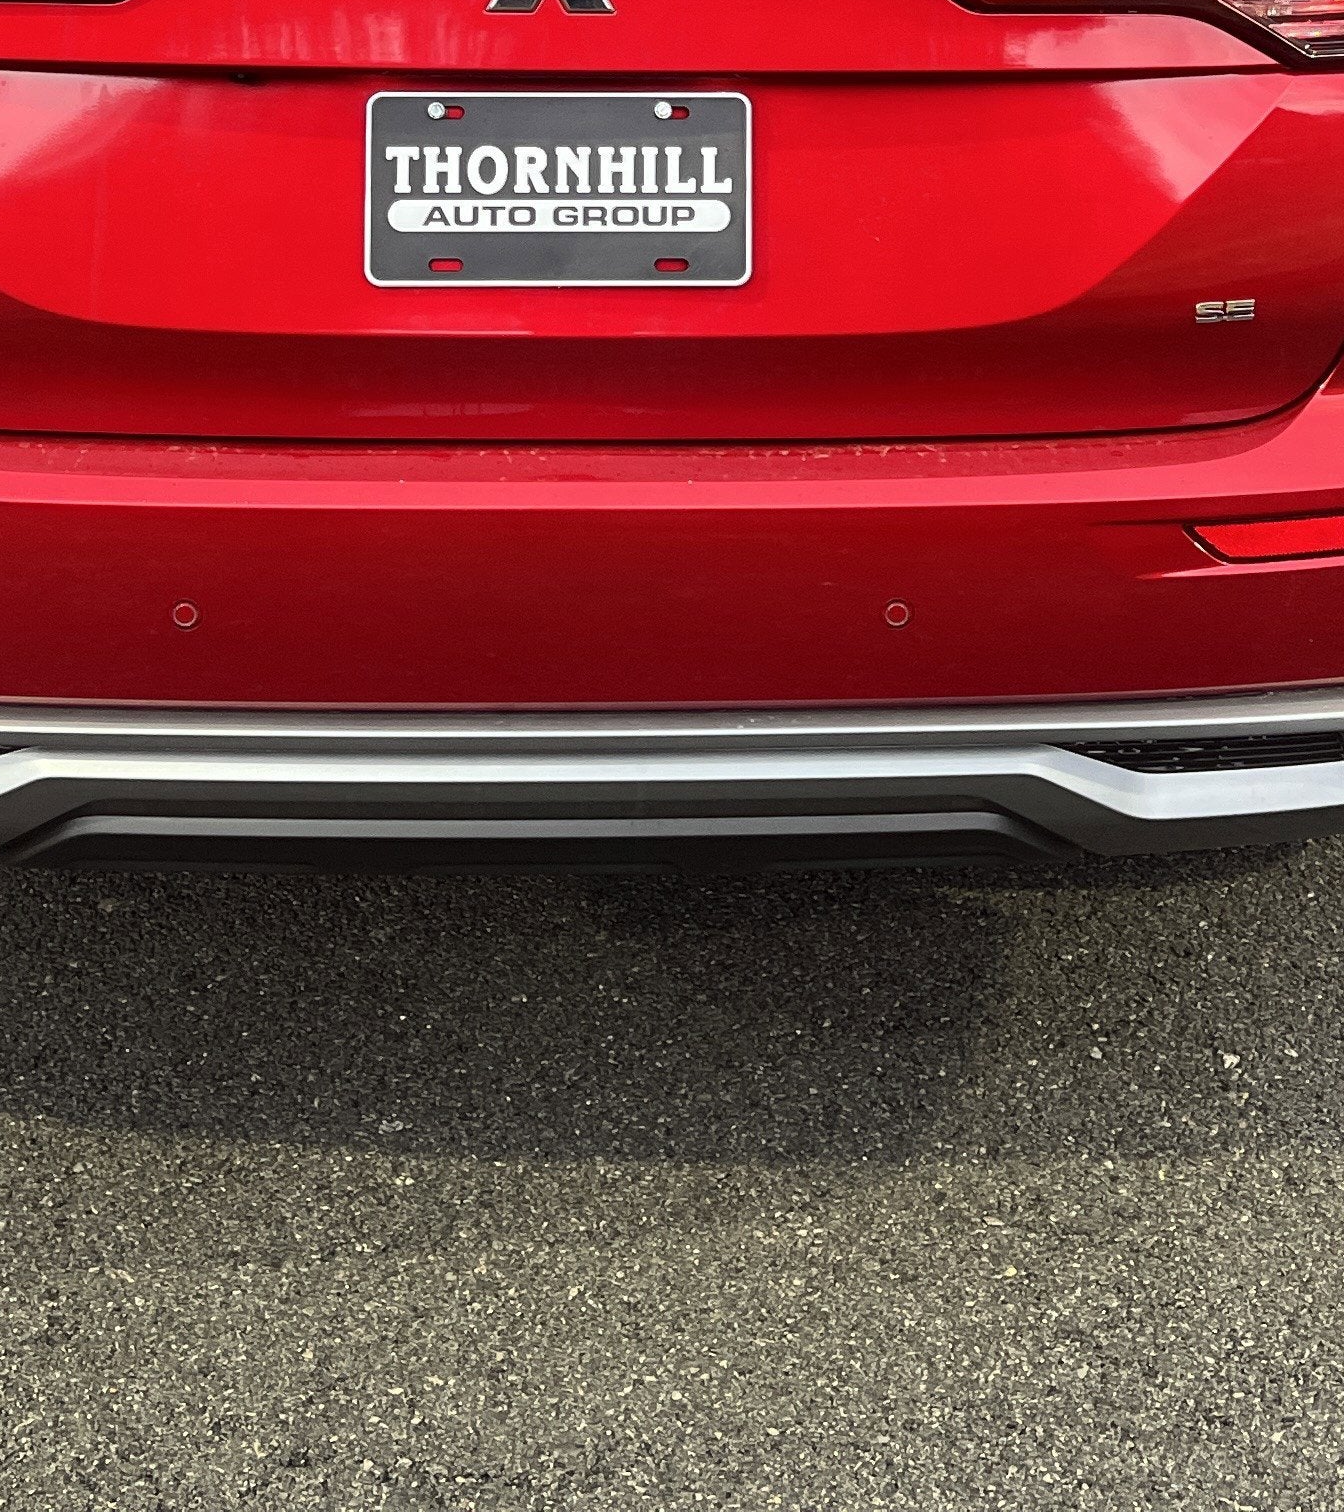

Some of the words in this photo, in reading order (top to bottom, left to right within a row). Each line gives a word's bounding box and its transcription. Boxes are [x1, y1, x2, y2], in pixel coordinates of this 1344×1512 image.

[385, 144, 734, 196] THORNHILL
[423, 205, 537, 227] AUTO
[553, 205, 696, 227] GROUP
[1194, 298, 1256, 324] SE
